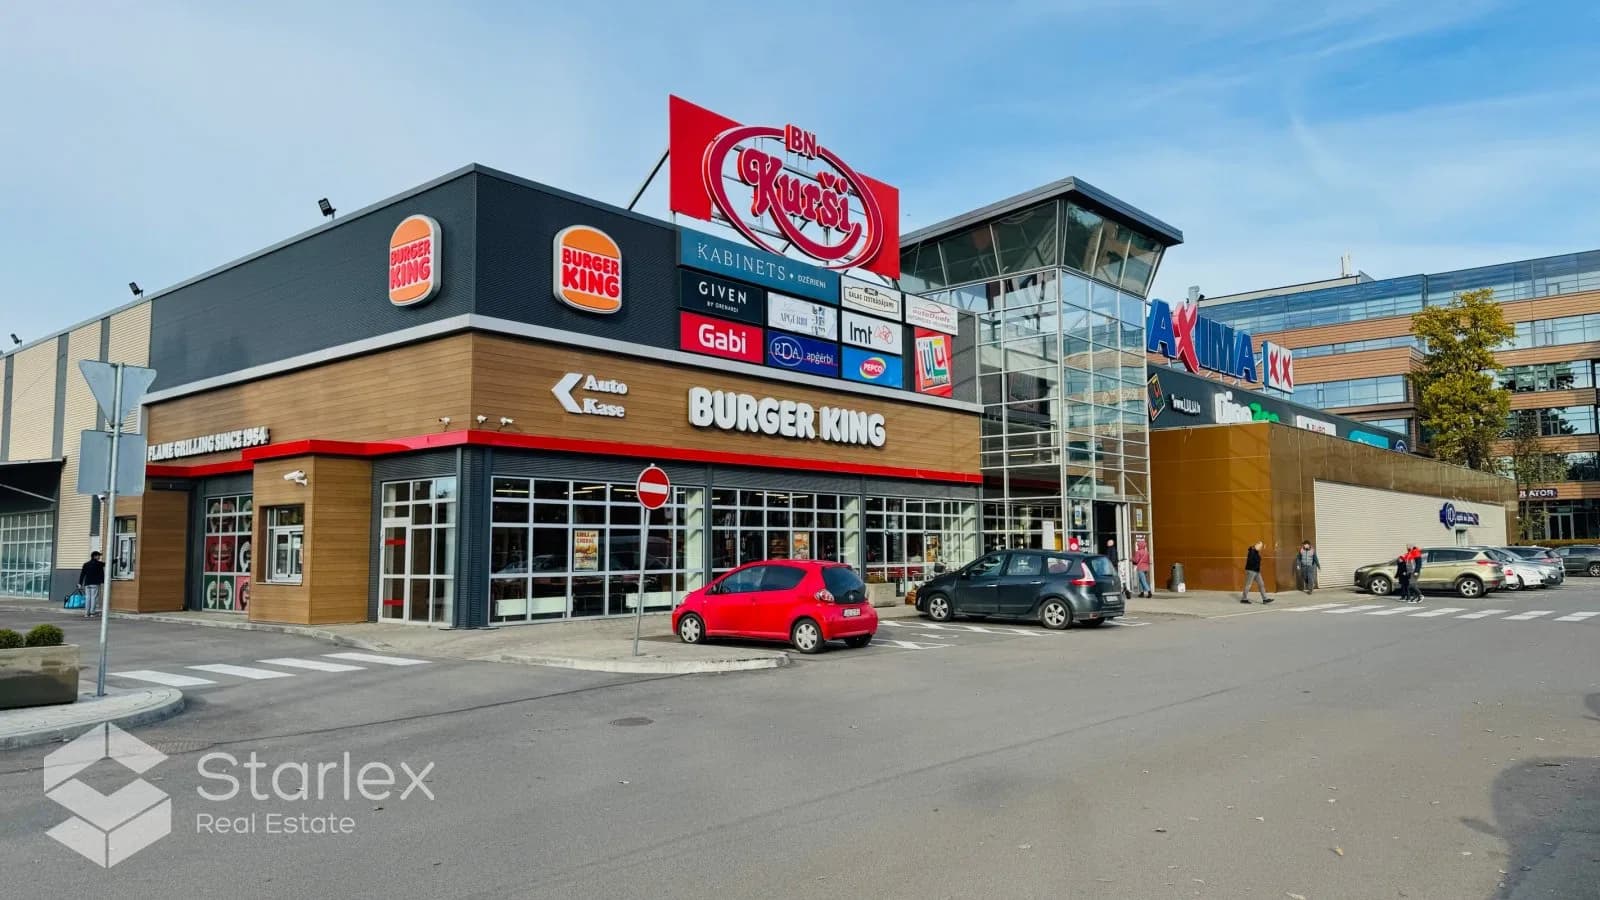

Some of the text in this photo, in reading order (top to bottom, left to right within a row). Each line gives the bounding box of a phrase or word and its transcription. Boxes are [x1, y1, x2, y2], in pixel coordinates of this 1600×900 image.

[785, 124, 816, 160] BN
[737, 148, 860, 250] Kurši
[390, 239, 431, 266] BURGER
[562, 247, 620, 276] BURGER
[698, 242, 786, 281] KABINETS
[390, 260, 431, 290] KING
[562, 268, 620, 298] KING
[698, 281, 747, 305] GIVEN
[698, 323, 747, 355] Gabi
[849, 321, 873, 345] lmt
[1147, 299, 1258, 383] AXIMA
[774, 342, 801, 360] RDA
[862, 362, 884, 373] PEPCO
[583, 374, 628, 395] Auto
[583, 398, 625, 418] Kase
[688, 386, 886, 447] BURGER KING
[147, 442, 174, 462] FLAME
[174, 434, 216, 458] GRILLING
[215, 429, 242, 452] SINCE
